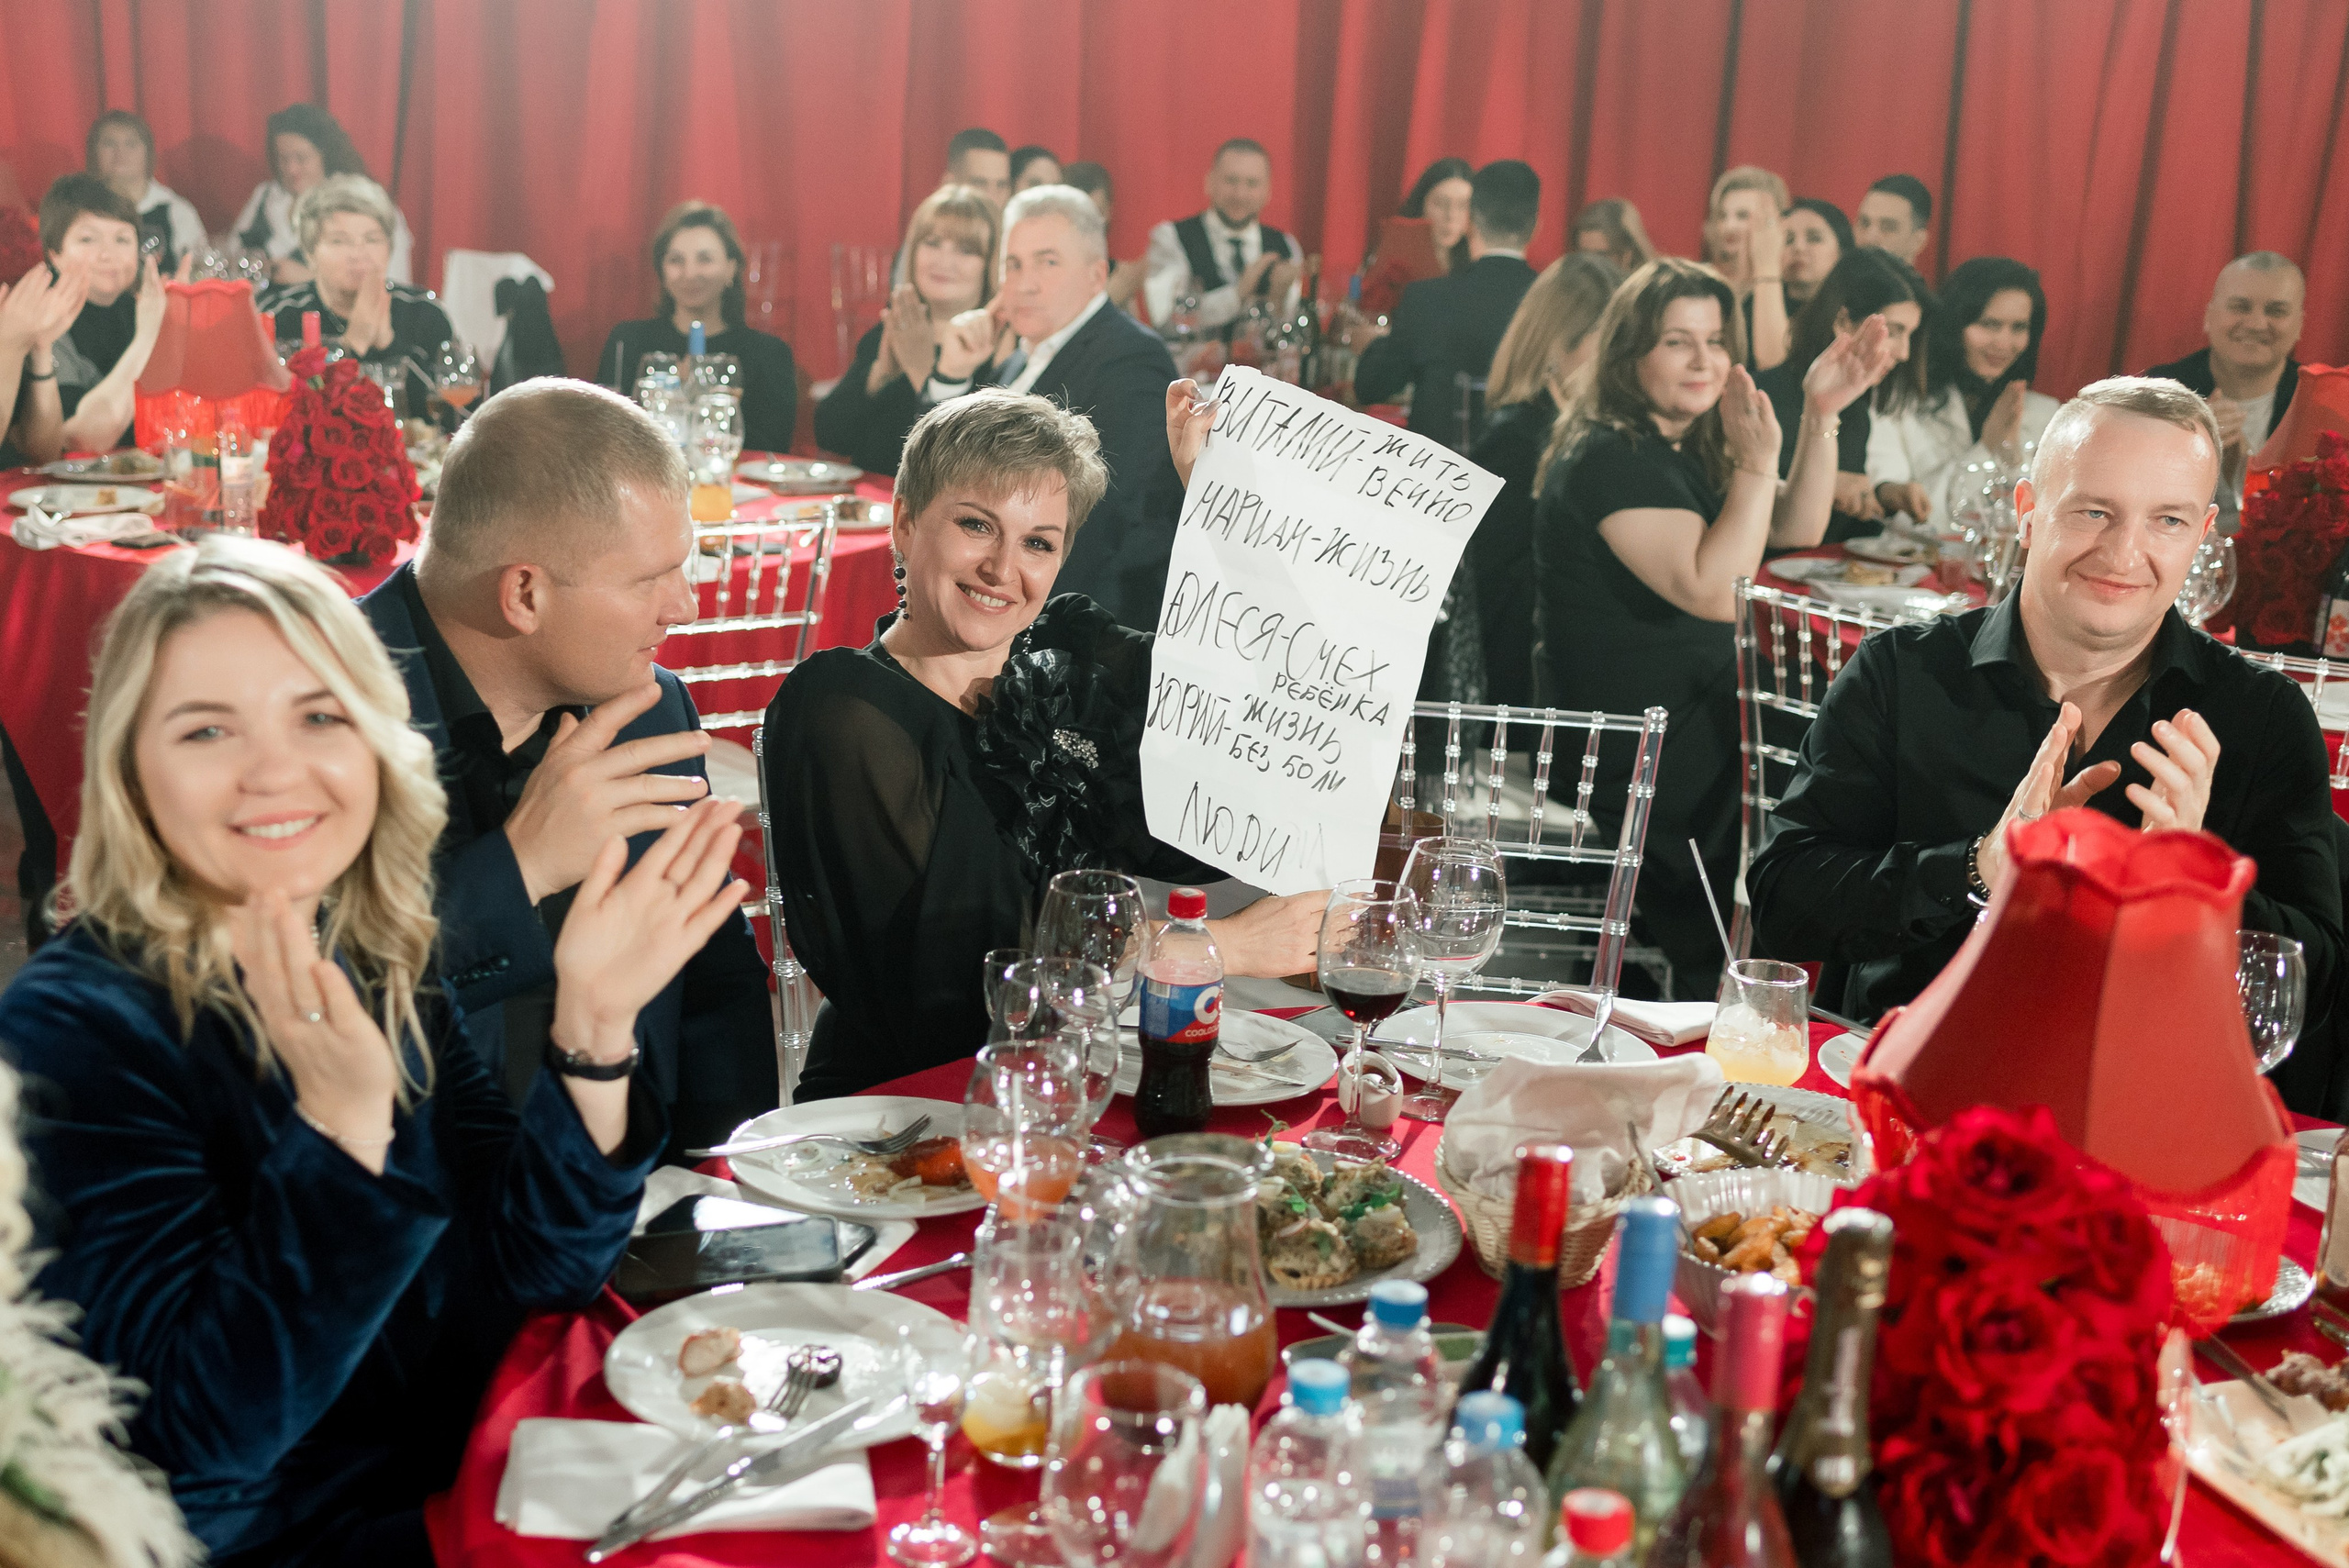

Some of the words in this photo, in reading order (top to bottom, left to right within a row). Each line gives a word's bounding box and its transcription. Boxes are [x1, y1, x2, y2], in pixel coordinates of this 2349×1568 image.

[1373, 434, 1470, 491] ЖИТЬ
[1357, 466, 1473, 523] ВЕЧНО
[1243, 694, 1341, 764] ЖИЗНЬ
[1229, 733, 1270, 772] БЕЗ
[1282, 754, 1347, 793] БОЛИ
